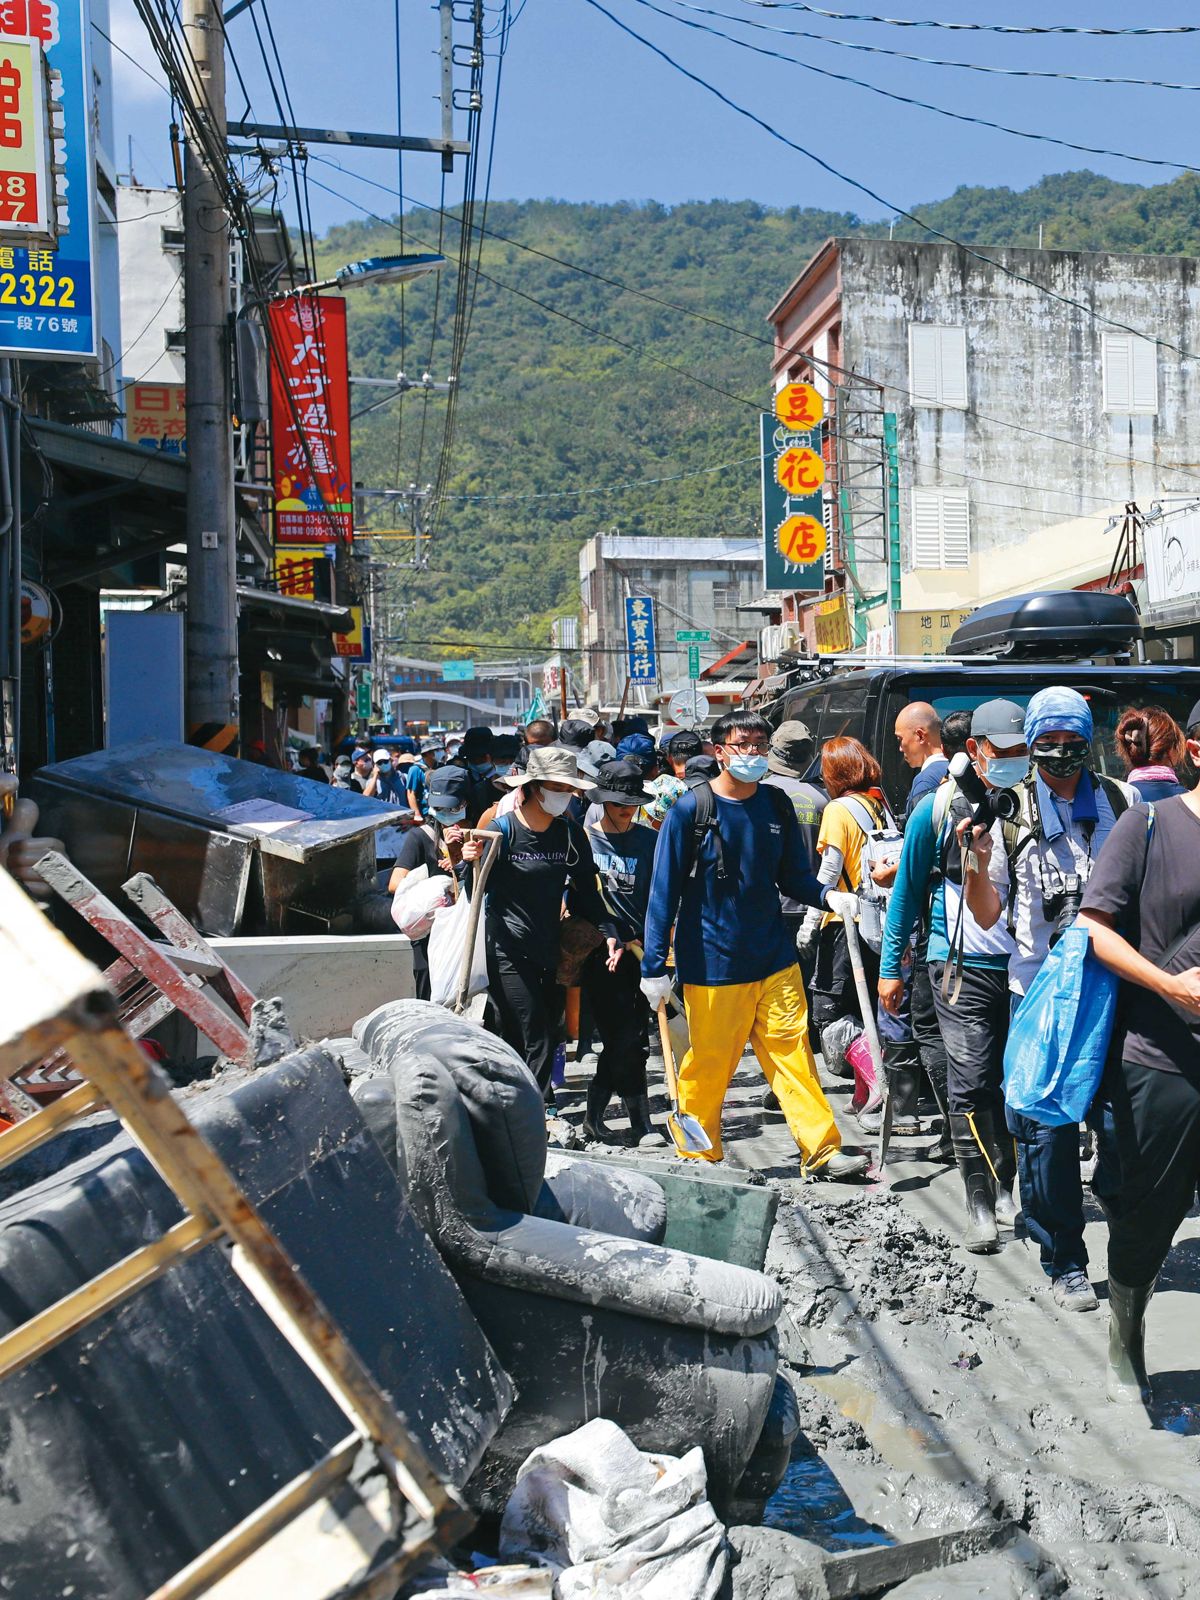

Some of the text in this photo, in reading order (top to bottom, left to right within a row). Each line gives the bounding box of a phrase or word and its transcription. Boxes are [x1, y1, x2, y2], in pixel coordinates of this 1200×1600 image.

[134, 387, 185, 411] 日
[781, 386, 819, 559] 豆花店
